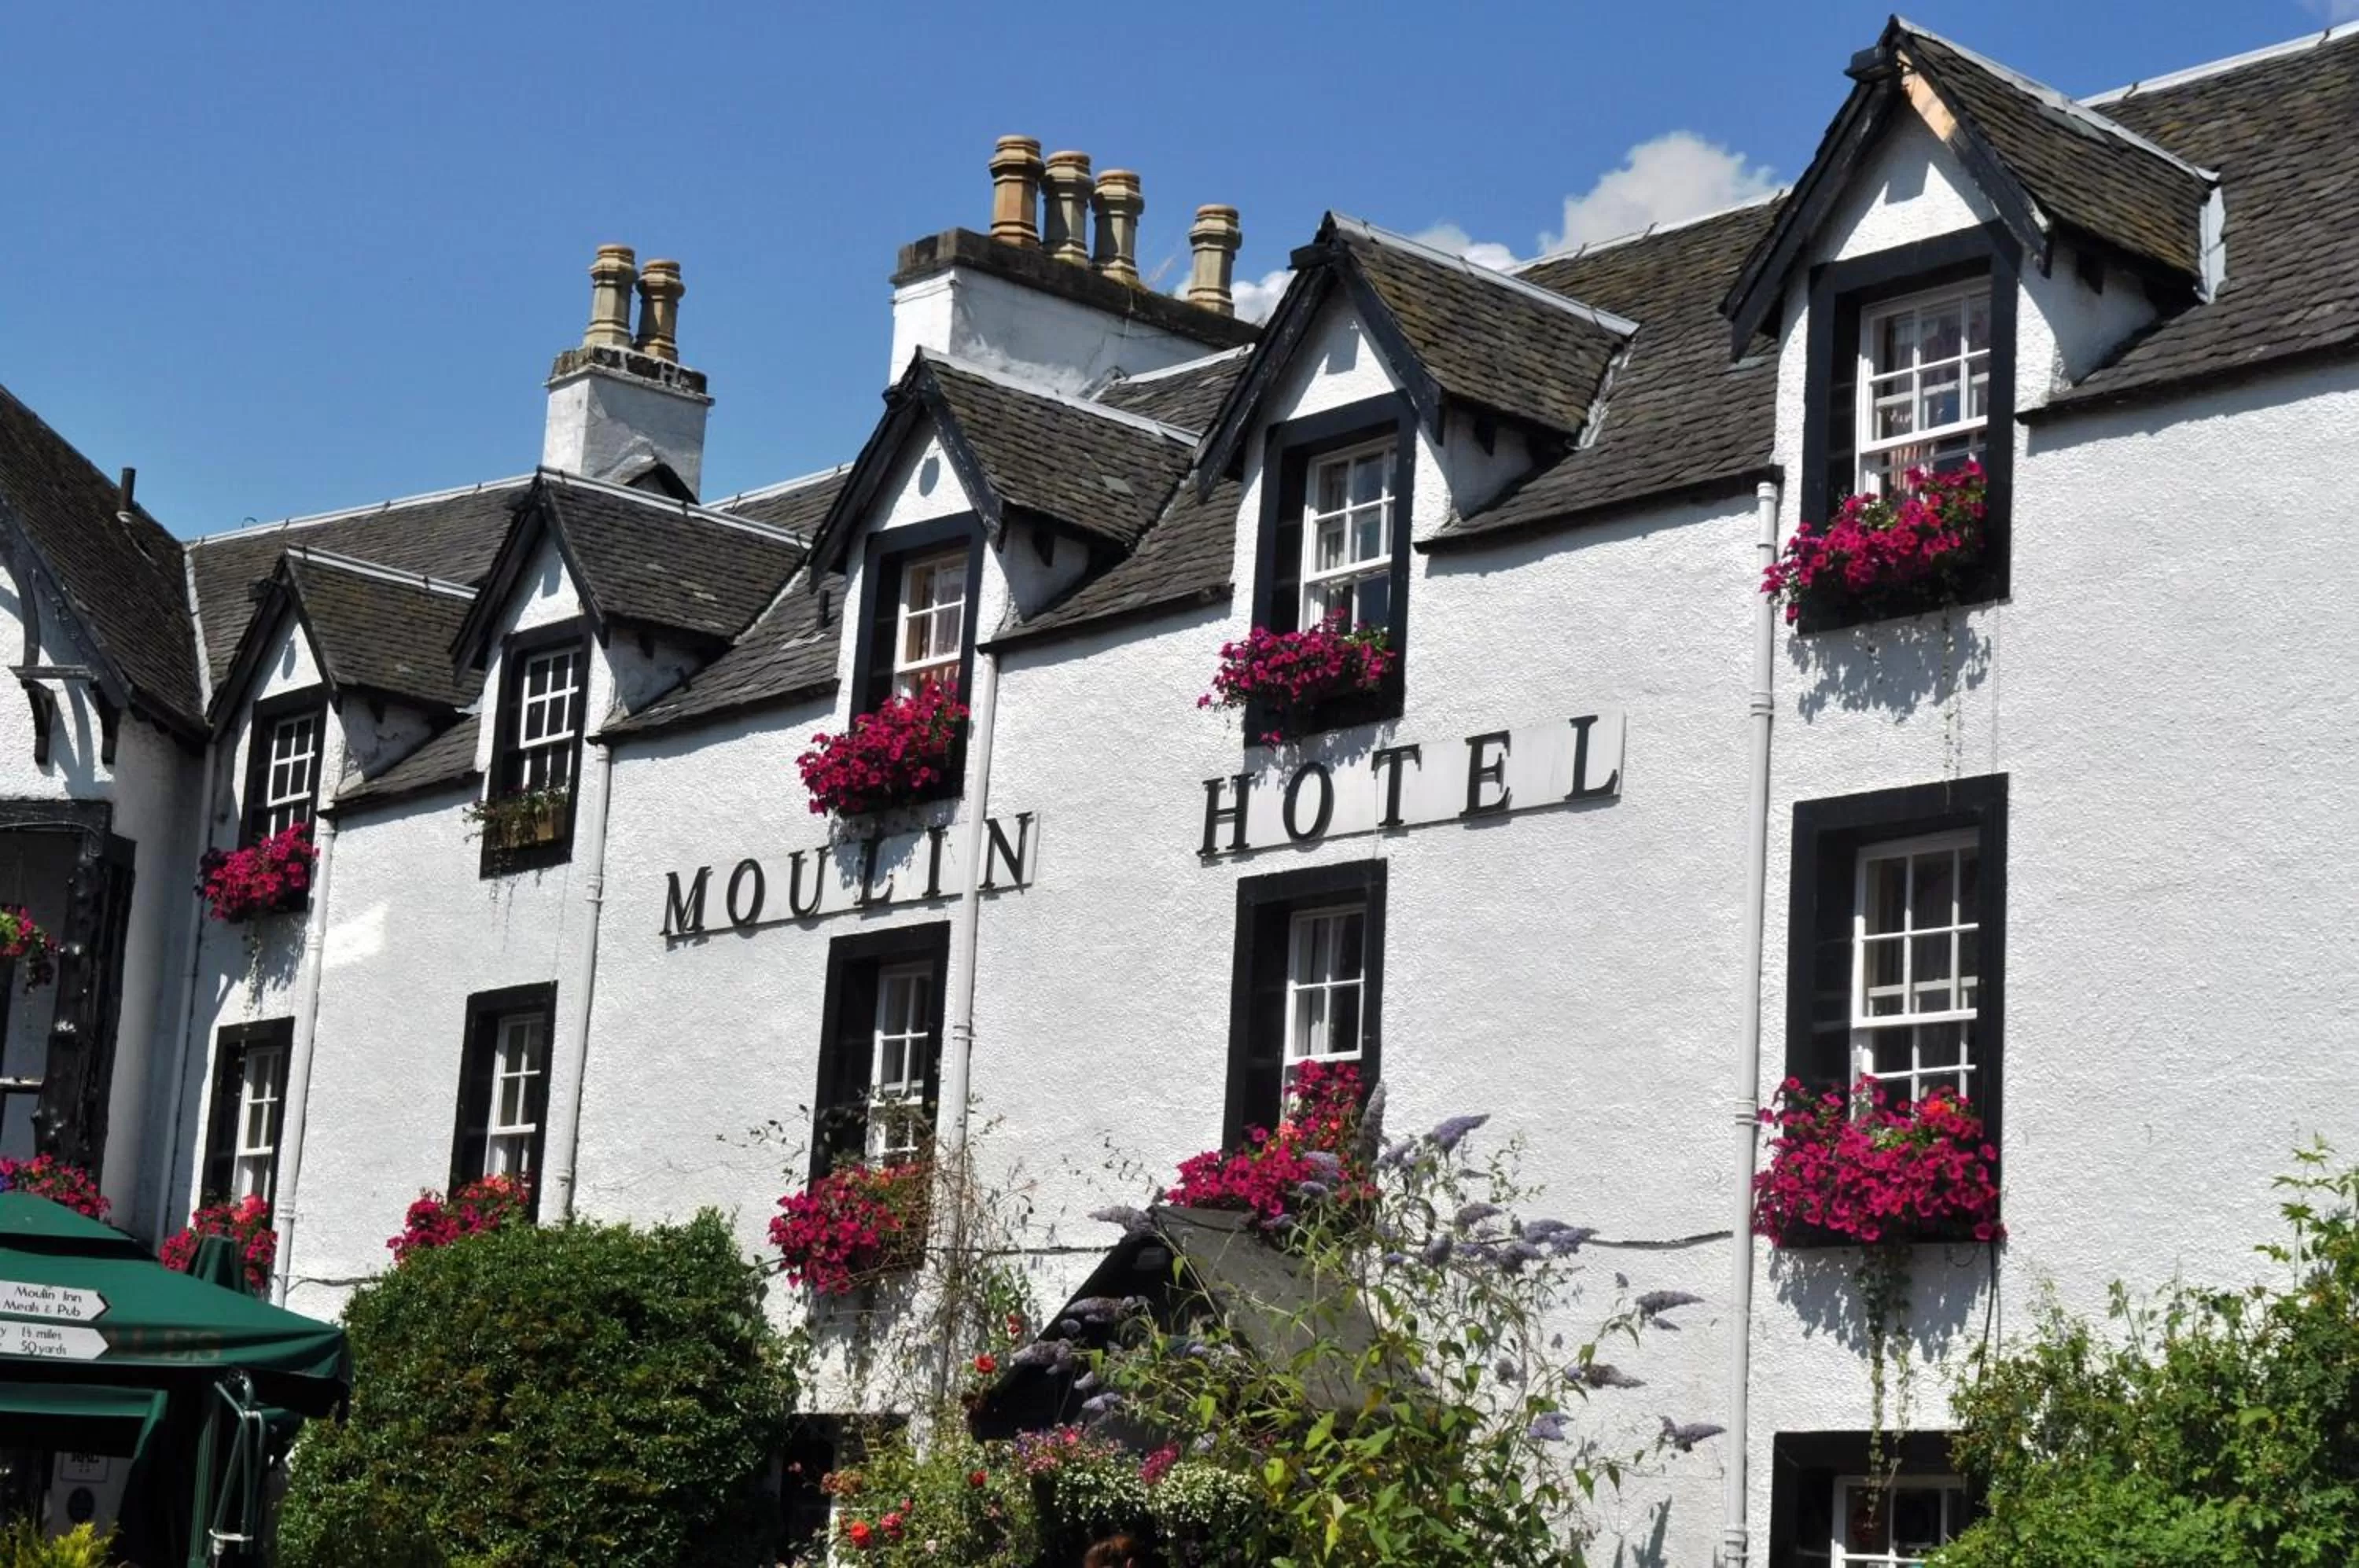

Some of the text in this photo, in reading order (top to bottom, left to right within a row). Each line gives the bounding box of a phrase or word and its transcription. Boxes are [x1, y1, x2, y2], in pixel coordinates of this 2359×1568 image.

[658, 714, 1618, 936] MOULIN HOTEL
[15, 1286, 83, 1302] Moulin Inn
[3, 1299, 39, 1312] Meals
[57, 1304, 81, 1317] Pub
[36, 1328, 62, 1340] miles
[21, 1340, 67, 1355] 50 yards
